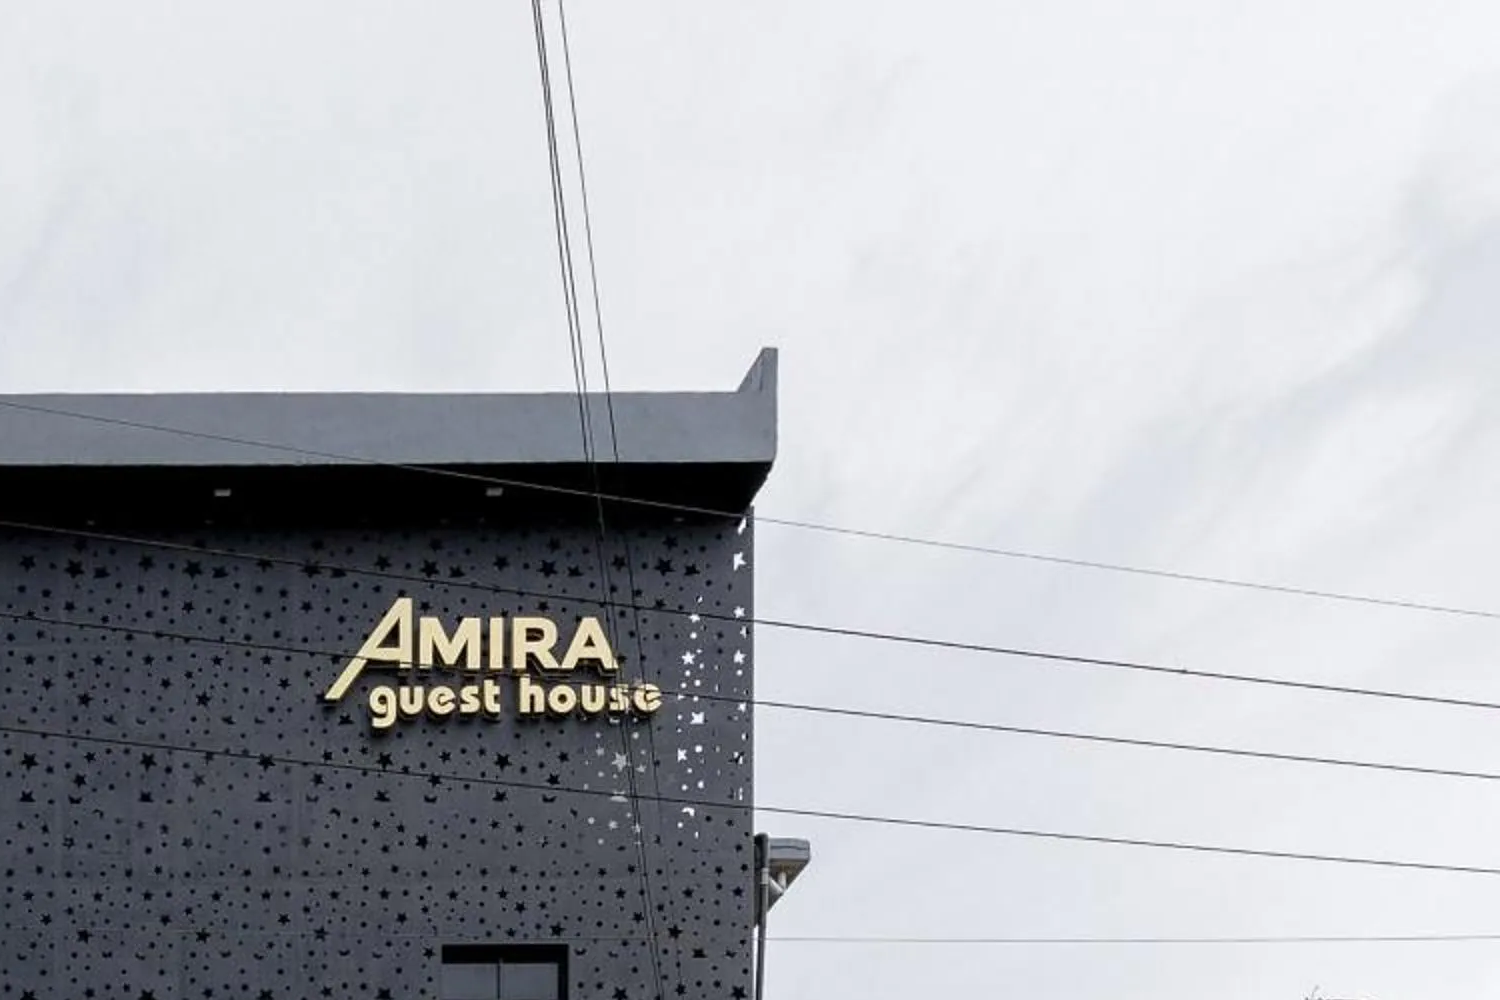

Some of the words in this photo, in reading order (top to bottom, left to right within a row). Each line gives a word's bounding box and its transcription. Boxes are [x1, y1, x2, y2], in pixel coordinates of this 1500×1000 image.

[324, 597, 619, 700] AMIRA
[370, 684, 500, 730] guest
[519, 673, 662, 714] house
